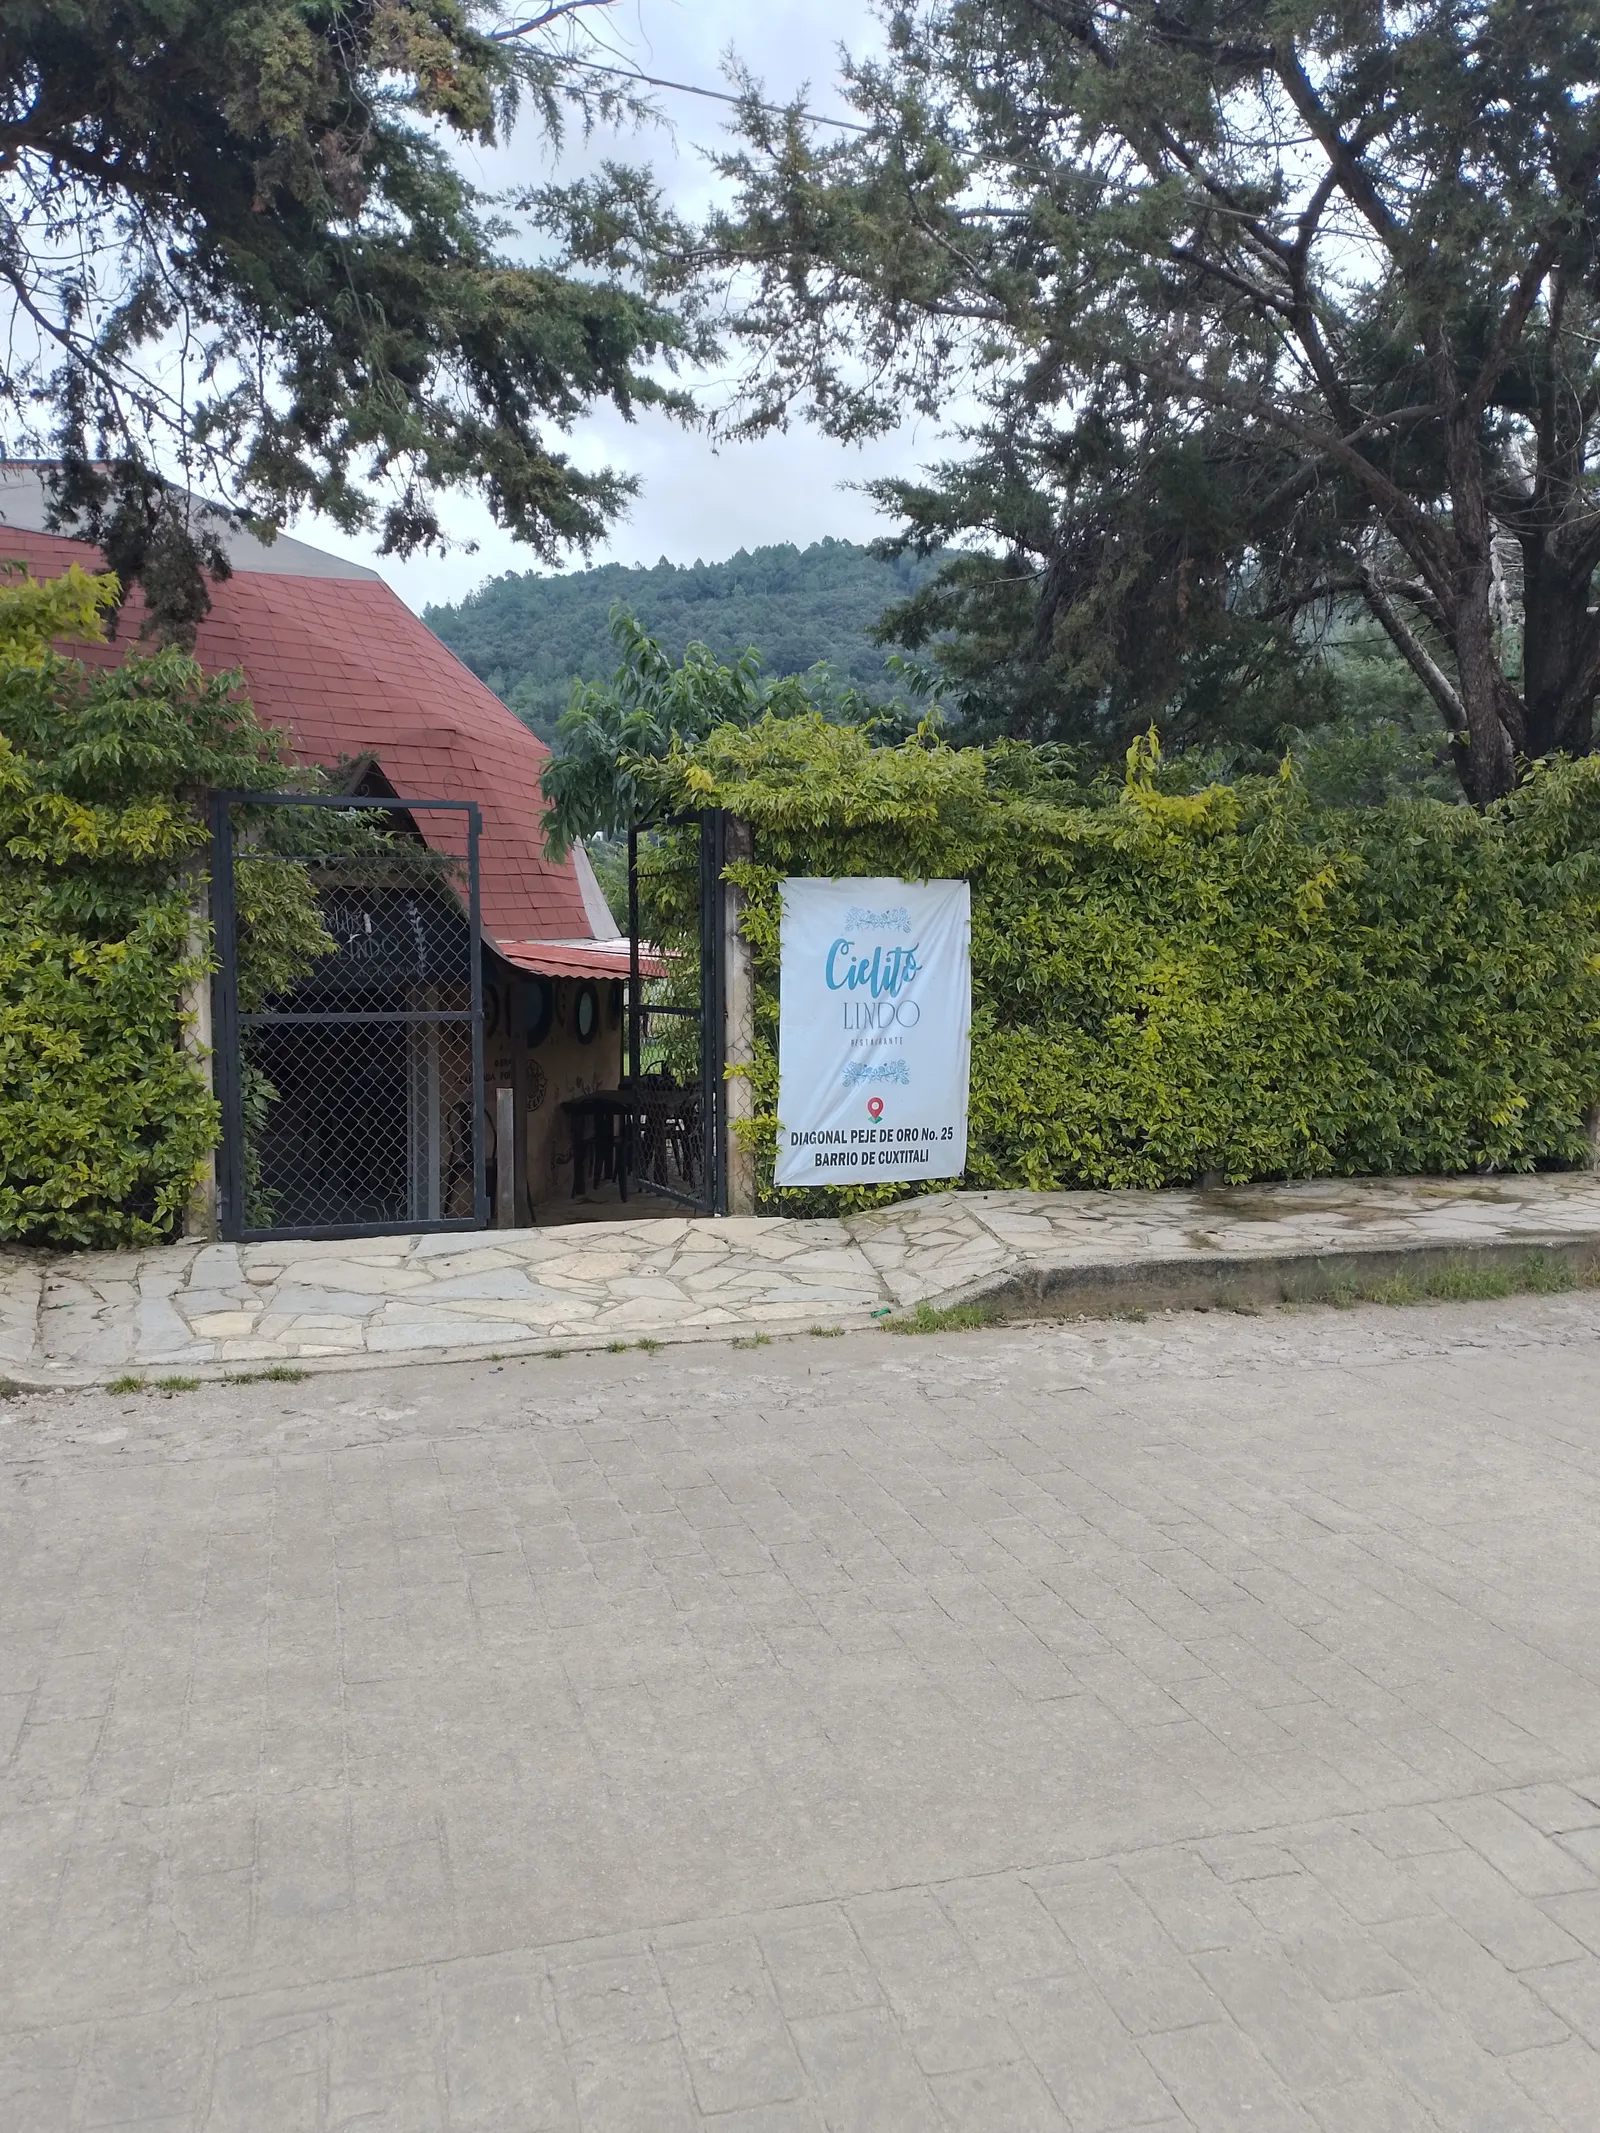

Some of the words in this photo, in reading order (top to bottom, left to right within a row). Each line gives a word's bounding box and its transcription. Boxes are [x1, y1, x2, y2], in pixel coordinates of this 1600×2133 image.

[825, 938, 923, 999] Cielito
[843, 1000, 920, 1030] LINDO
[790, 1130, 848, 1146] DIAGONAL
[850, 1129, 877, 1144] PEJE
[879, 1128, 894, 1143] DE
[896, 1128, 919, 1142] ORO
[921, 1127, 938, 1141] No.
[940, 1126, 954, 1141] 25
[814, 1152, 859, 1167] BARRIO
[861, 1151, 876, 1165] DE
[878, 1148, 929, 1165] CUXTITALI
